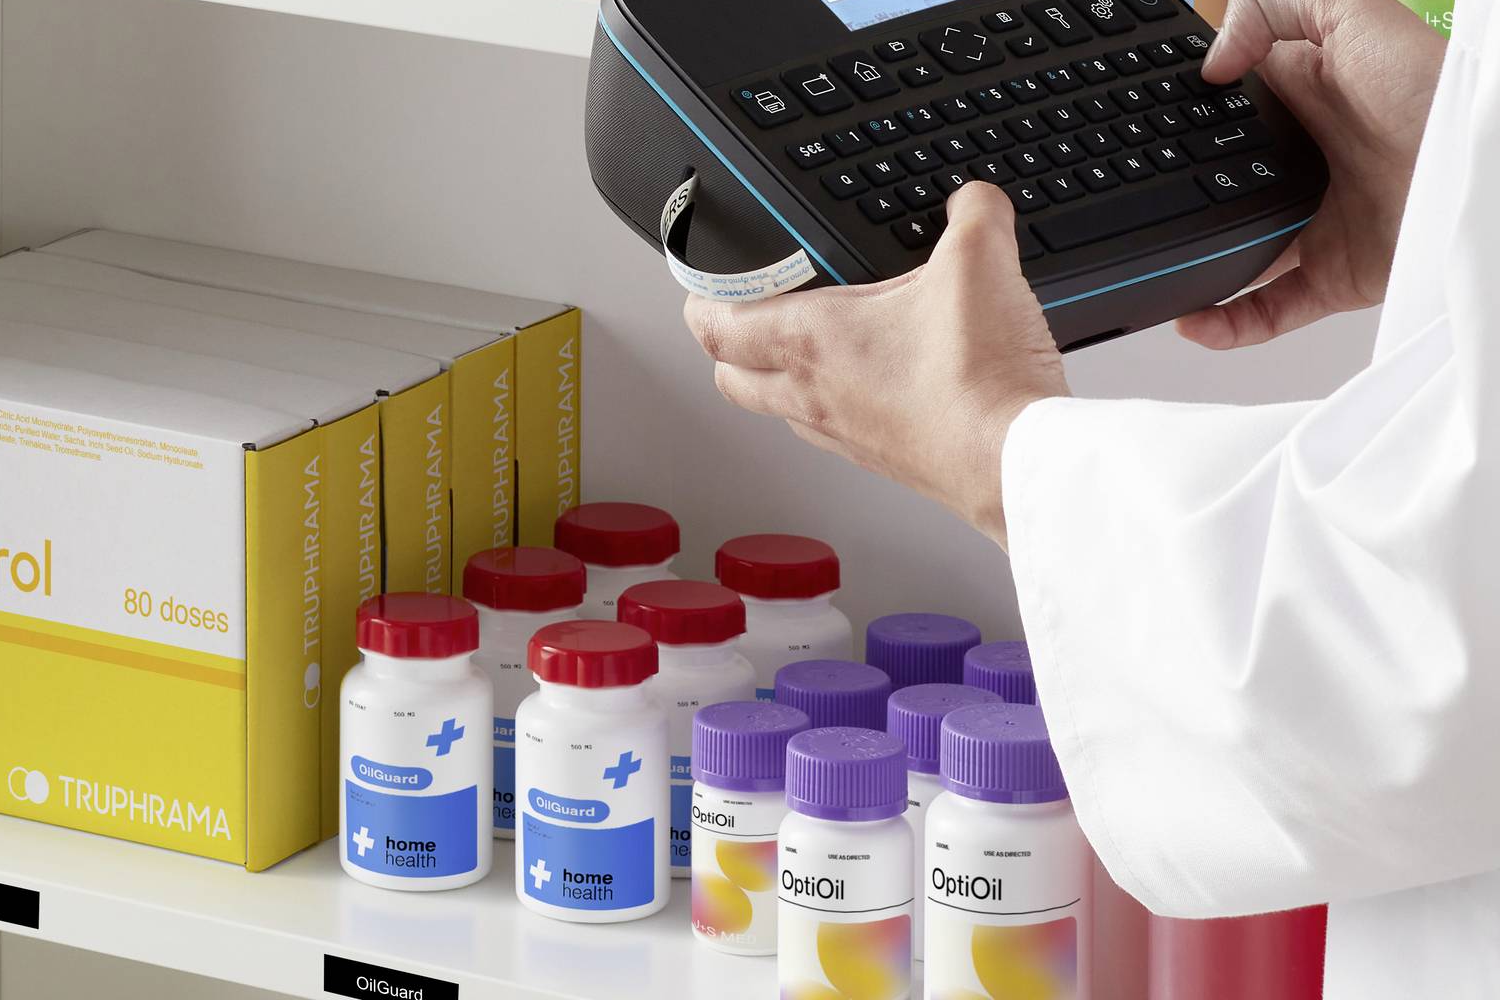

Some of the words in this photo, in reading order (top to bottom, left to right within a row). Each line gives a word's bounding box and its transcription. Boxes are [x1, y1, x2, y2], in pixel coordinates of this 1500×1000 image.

[1128, 90, 1140, 101] O
[1161, 81, 1172, 92] P
[1057, 108, 1070, 119] U
[1094, 99, 1104, 110] I
[1021, 118, 1033, 130] Y
[986, 129, 998, 140] T
[950, 139, 964, 151] R
[914, 150, 928, 161] E
[875, 161, 891, 173] W
[840, 174, 853, 186] Q
[303, 454, 321, 655] TRUPHRAMA
[123, 588, 152, 618] 80
[160, 594, 229, 635] doses
[359, 762, 419, 785] OilGuard
[58, 775, 232, 841] TRUPHRAMA
[535, 795, 596, 818] OilGuard
[692, 805, 735, 828] OptiOil
[385, 835, 437, 852] home
[385, 850, 437, 869] health
[562, 867, 614, 885] home
[781, 869, 844, 900] OptiOil
[932, 867, 1002, 901] OptiOil
[562, 882, 614, 901] health
[356, 976, 423, 1000] OilGuard
